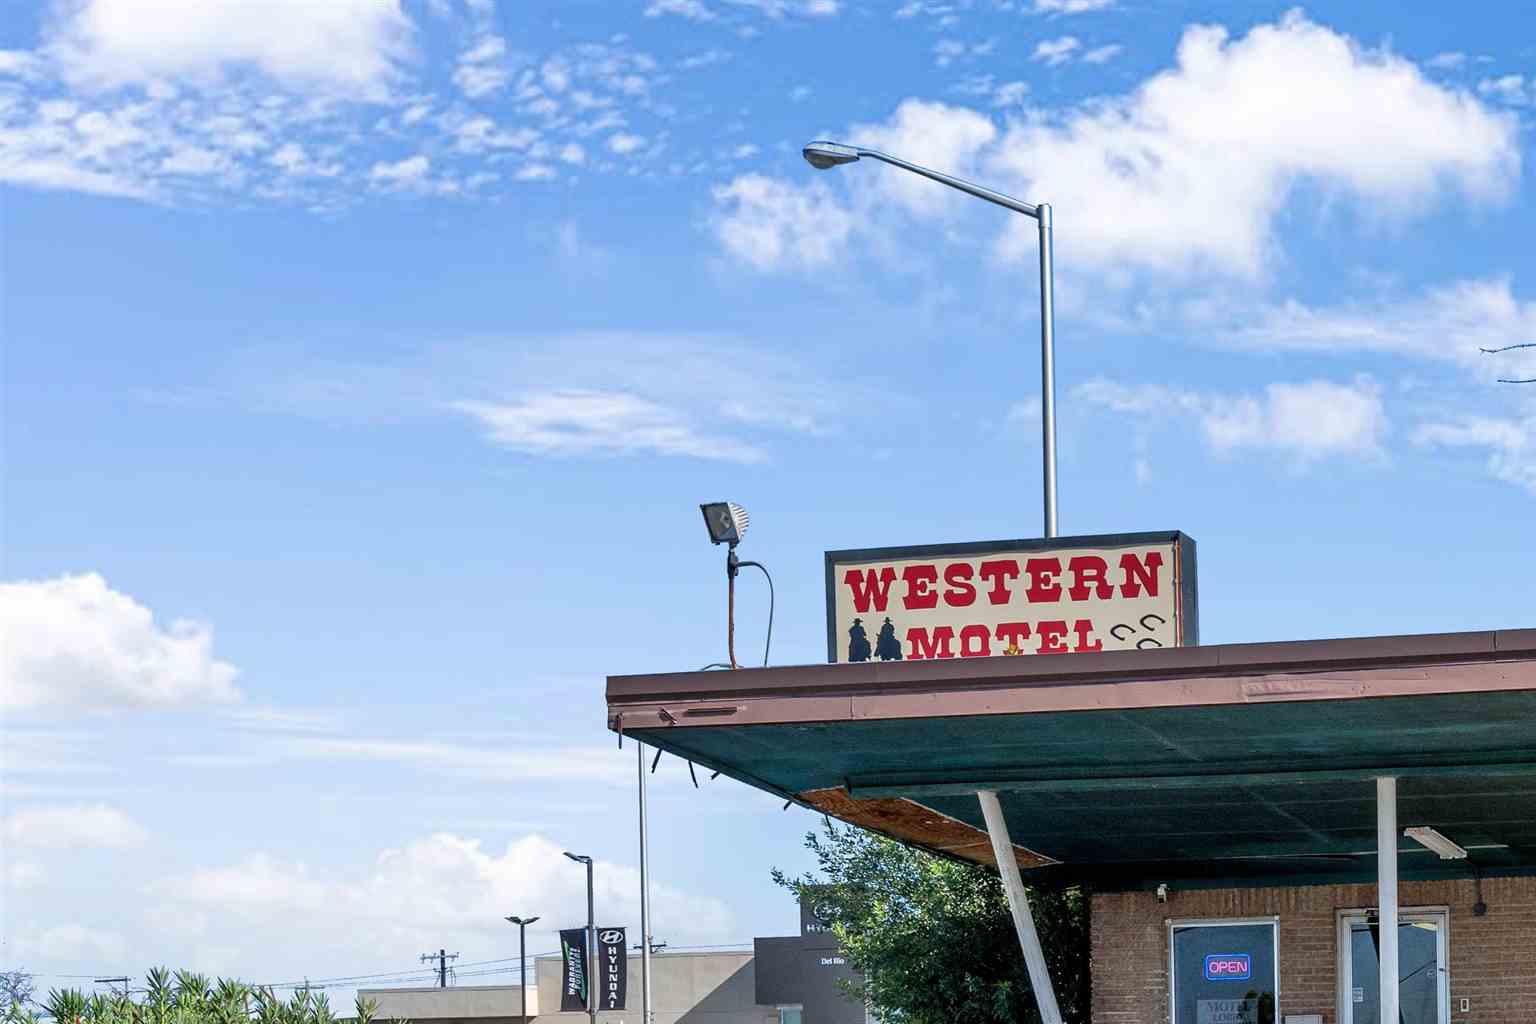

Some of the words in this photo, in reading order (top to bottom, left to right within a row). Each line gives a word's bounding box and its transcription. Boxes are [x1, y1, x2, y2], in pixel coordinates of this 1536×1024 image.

[844, 551, 1164, 614] WESTERN
[906, 619, 1102, 660] MOTEL
[608, 947, 618, 1008] HYUNDAI
[1208, 961, 1248, 973] OPEN
